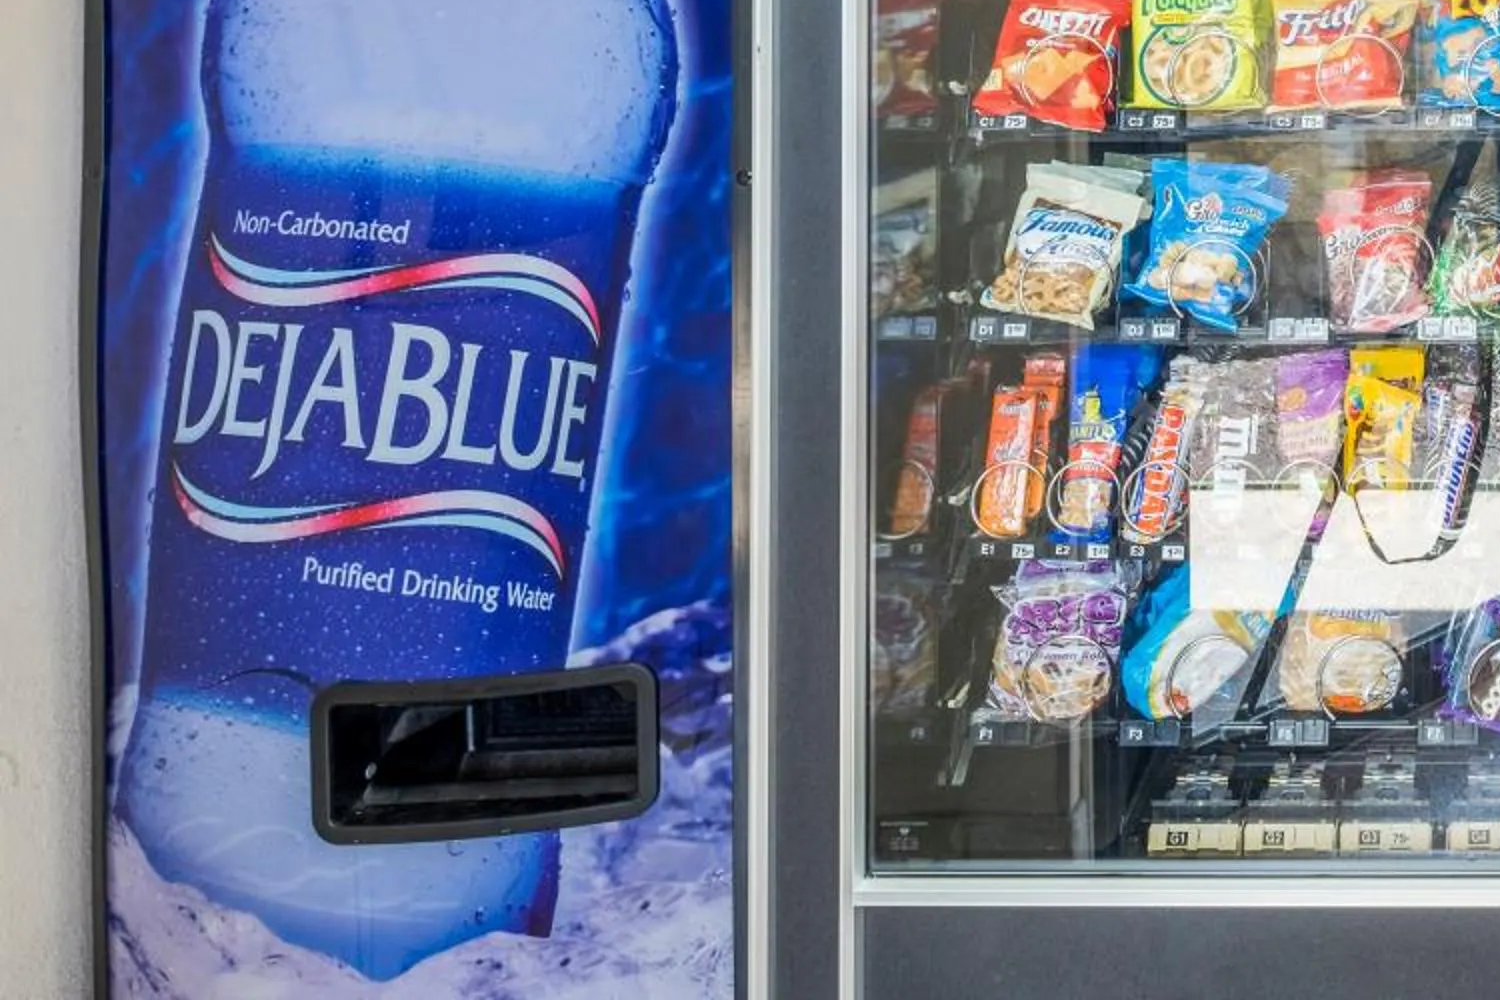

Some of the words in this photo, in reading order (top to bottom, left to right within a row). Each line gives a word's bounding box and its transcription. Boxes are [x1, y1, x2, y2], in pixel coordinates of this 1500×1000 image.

[1278, 0, 1366, 46] Frito
[233, 209, 411, 245] Non-Carbonated
[1015, 208, 1121, 243] Famous
[1137, 404, 1186, 535] PAYDAY
[981, 544, 995, 555] E1
[302, 556, 395, 594] Purified
[401, 570, 500, 613] Drinking
[506, 582, 555, 612] Water
[979, 729, 993, 740] F1
[1128, 729, 1143, 740] F3
